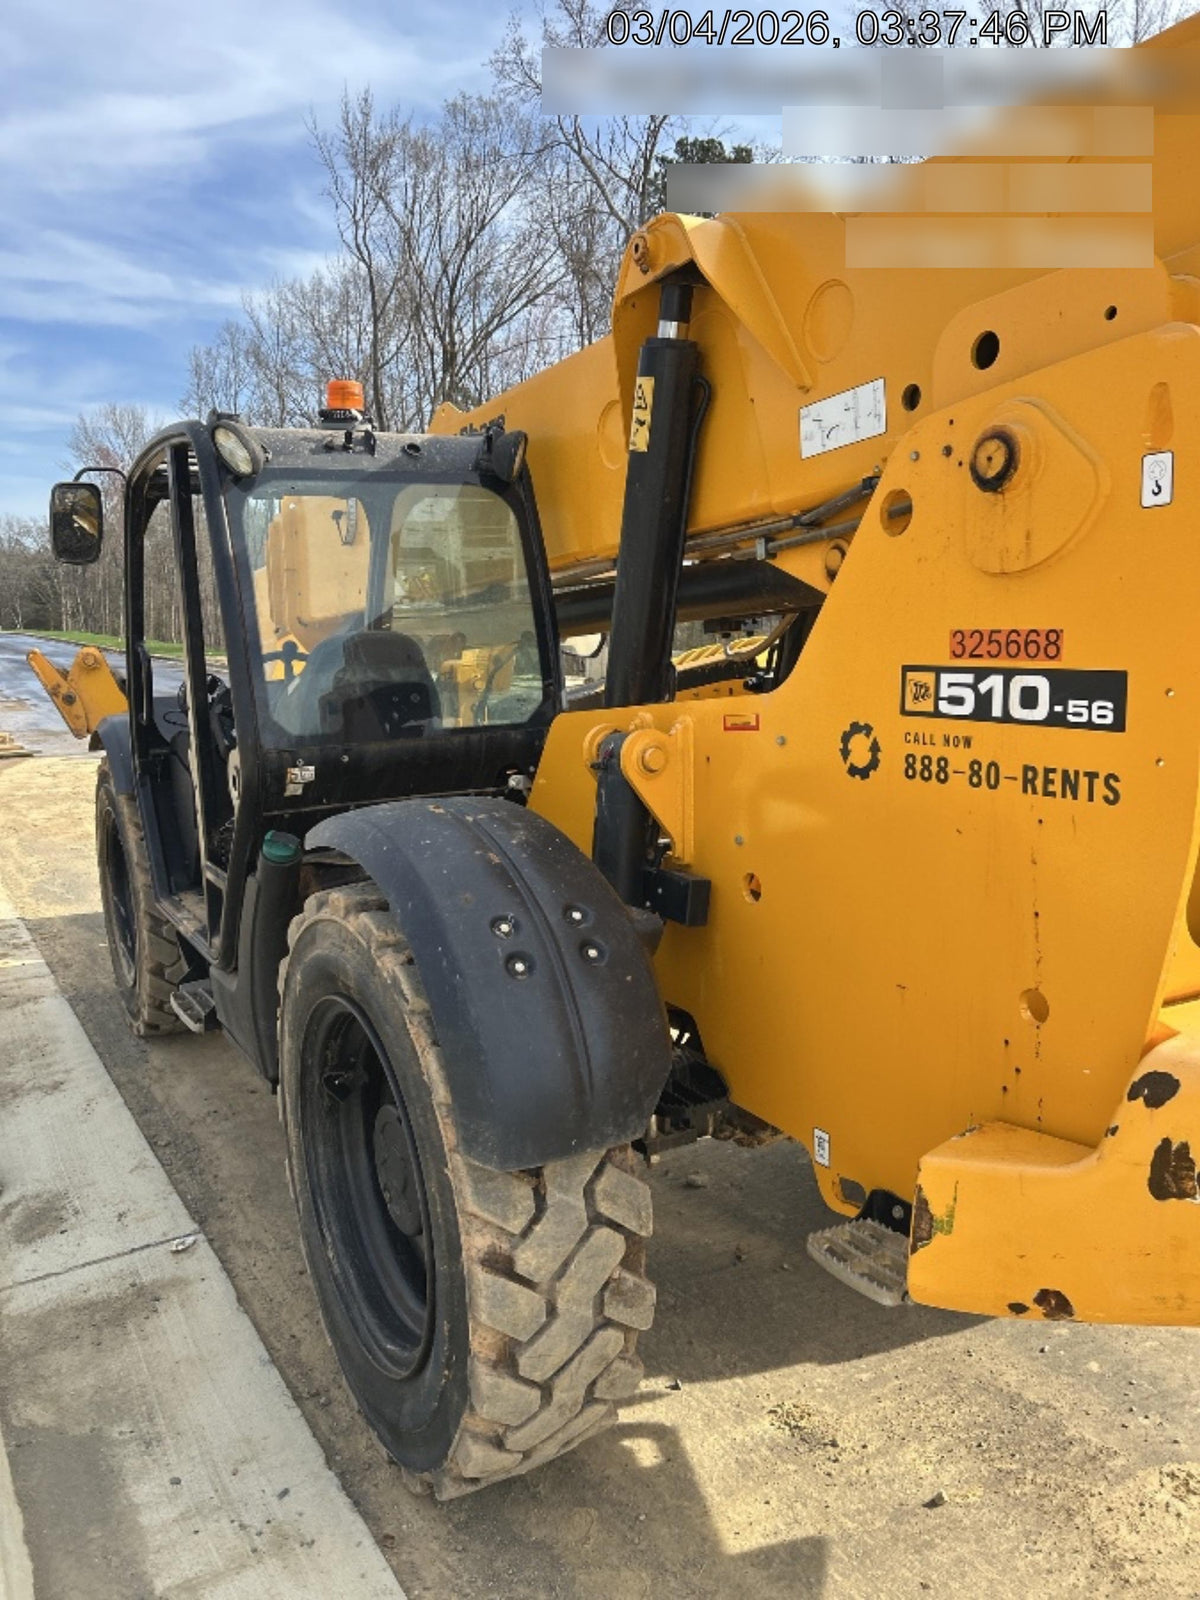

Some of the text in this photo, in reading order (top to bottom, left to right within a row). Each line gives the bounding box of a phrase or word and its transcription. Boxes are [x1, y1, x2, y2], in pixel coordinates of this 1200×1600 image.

[952, 628, 1062, 659] 325668
[904, 731, 974, 749] CALL NOW
[904, 753, 1121, 806] 888-80-RENTS
